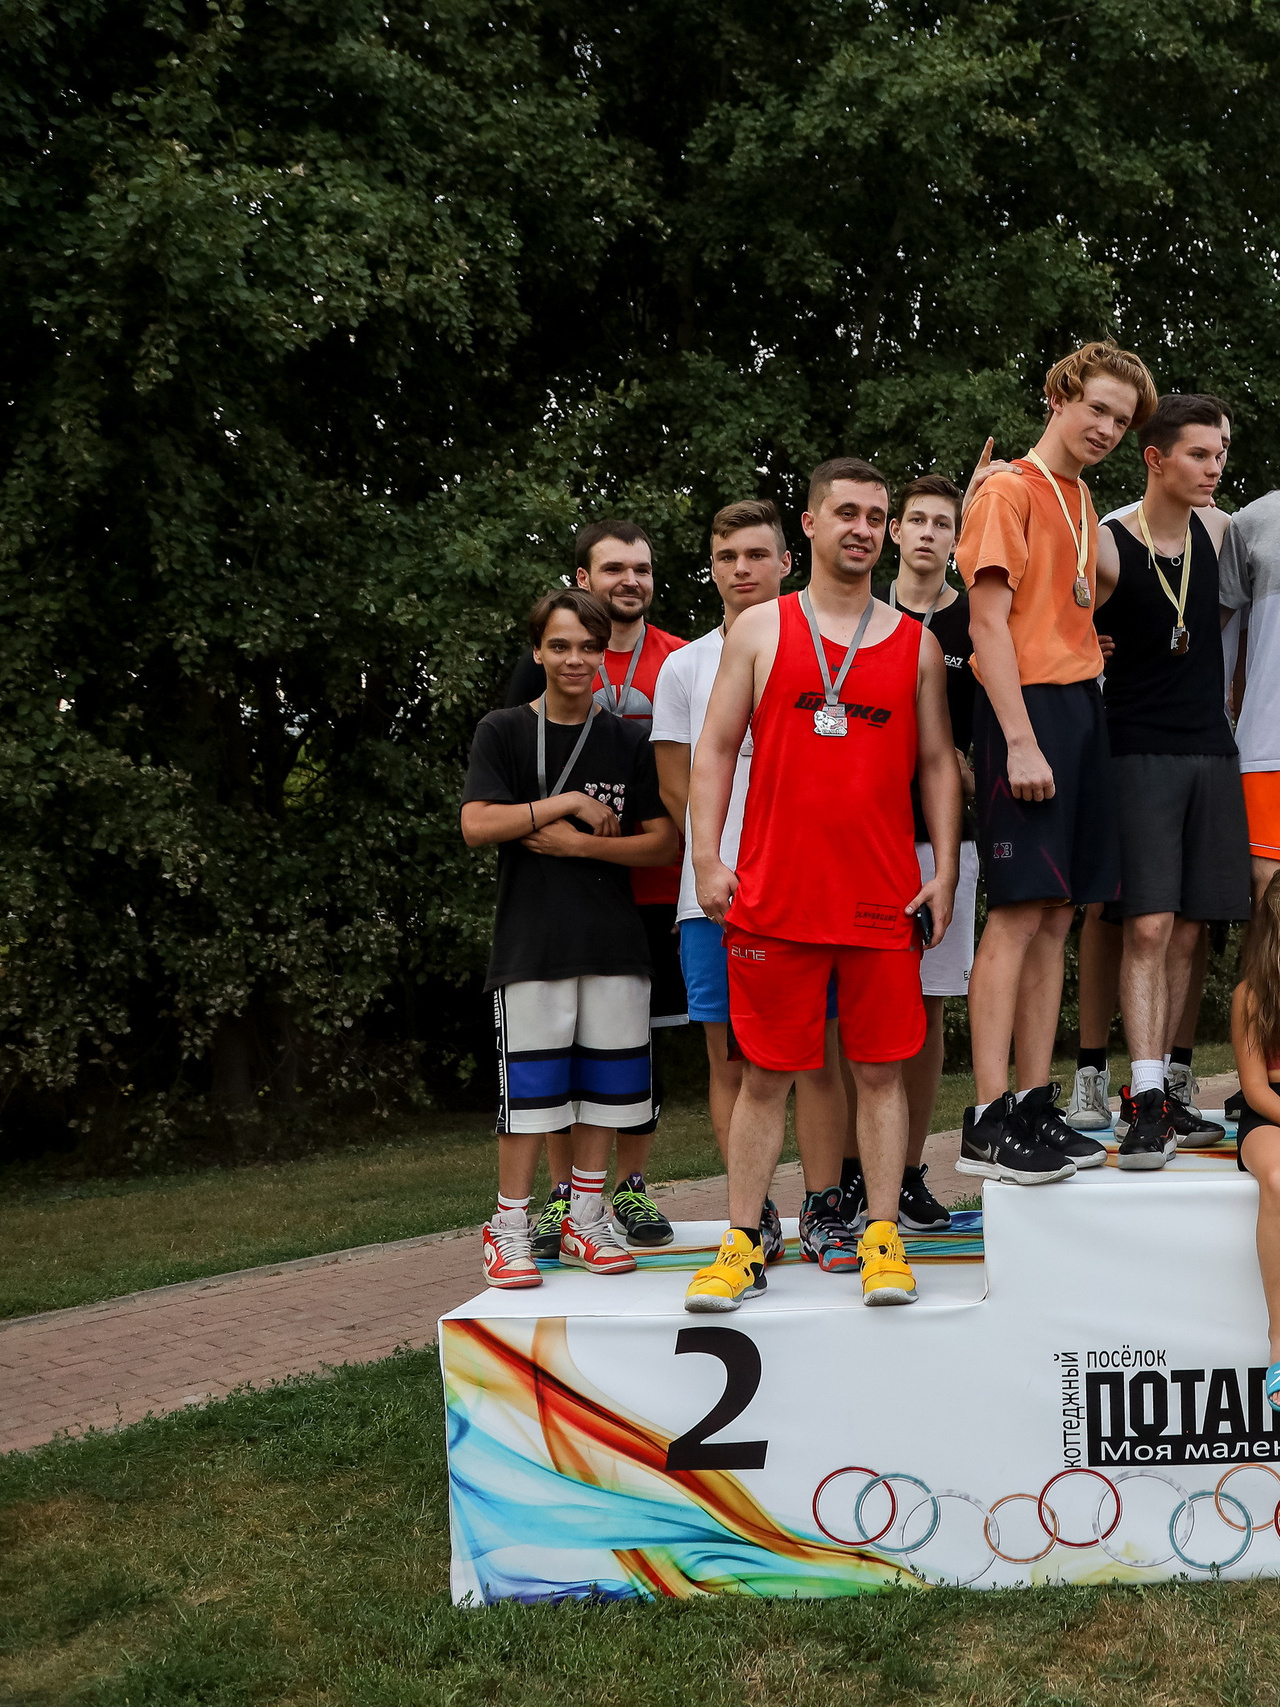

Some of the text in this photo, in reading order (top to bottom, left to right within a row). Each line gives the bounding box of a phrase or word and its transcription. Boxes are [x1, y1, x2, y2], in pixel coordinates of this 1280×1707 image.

[944, 654, 964, 667] EA7
[731, 945, 766, 961] ELITE
[1087, 1345, 1167, 1368] посёлок
[665, 1326, 769, 1471] 2
[1054, 1351, 1085, 1468] коттеджный
[1100, 1440, 1173, 1462] Моя
